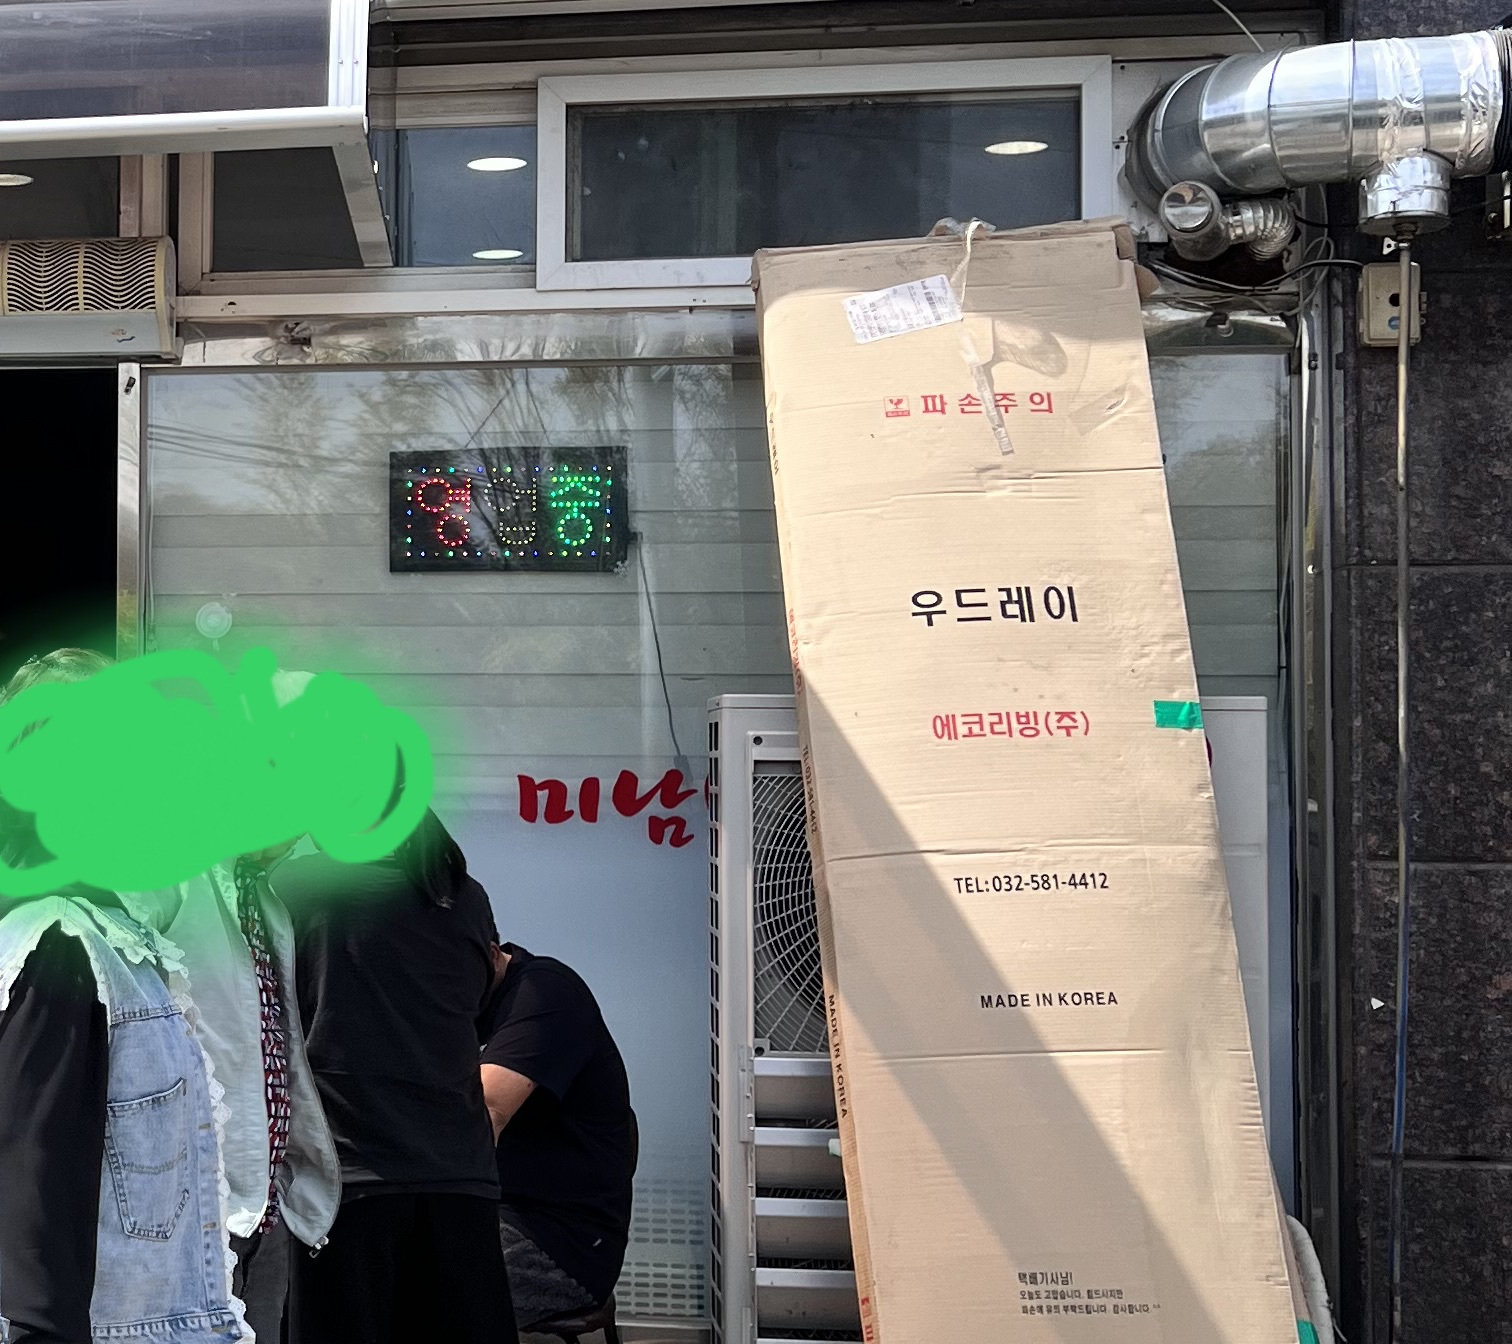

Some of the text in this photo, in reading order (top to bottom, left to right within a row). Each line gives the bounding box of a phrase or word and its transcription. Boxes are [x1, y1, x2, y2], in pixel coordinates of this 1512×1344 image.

[921, 391, 1054, 416] 파손주의
[417, 477, 601, 547] 영업중
[911, 585, 1080, 627] 우드레이
[932, 710, 1091, 741] 에코리빙(주)
[517, 768, 710, 848] 미남
[954, 872, 1110, 894] TEL:032-581-4412
[980, 992, 1119, 1009] MADE IN KOREA
